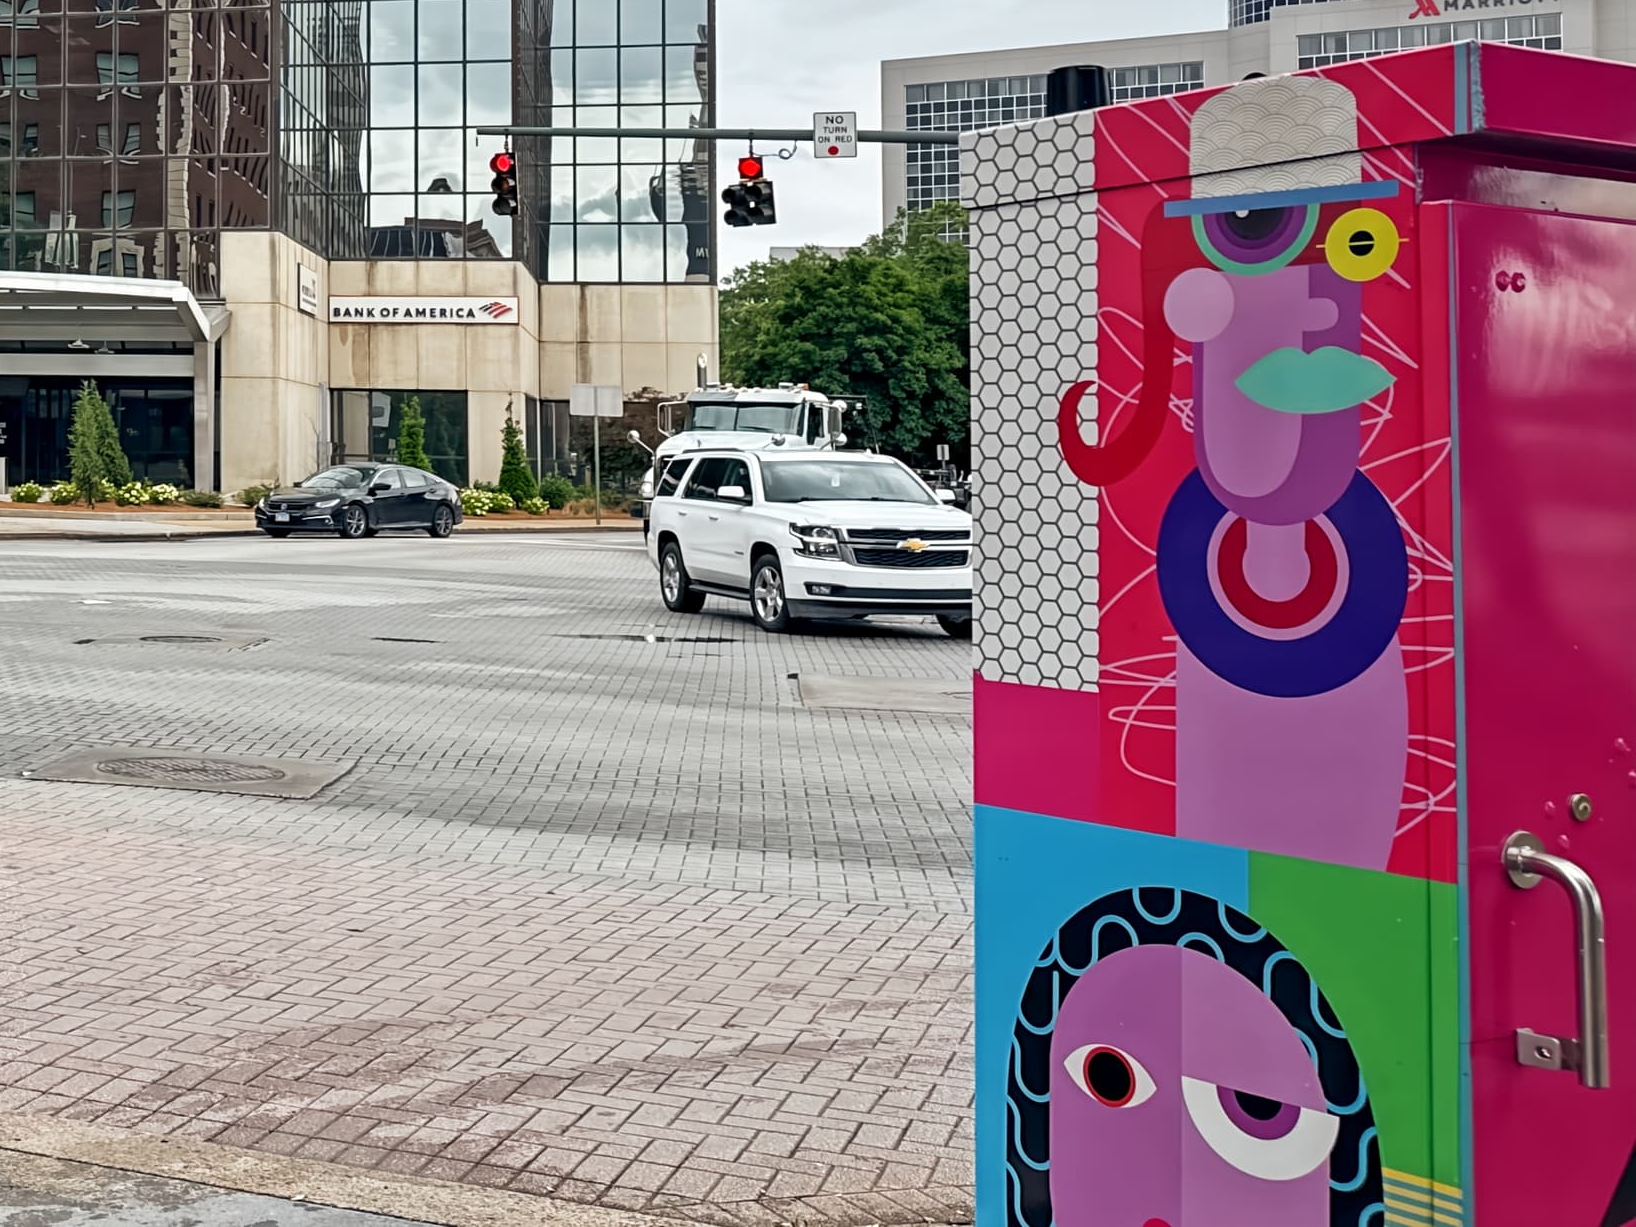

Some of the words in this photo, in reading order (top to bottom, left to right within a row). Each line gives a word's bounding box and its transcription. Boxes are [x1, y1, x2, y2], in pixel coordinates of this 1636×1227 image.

[825, 115, 844, 124] NO
[823, 126, 848, 134] TURN
[817, 135, 831, 143] ON
[835, 134, 853, 143] RED
[332, 307, 376, 319] BANK
[379, 307, 400, 319] OF
[403, 307, 476, 319] AMERICA
